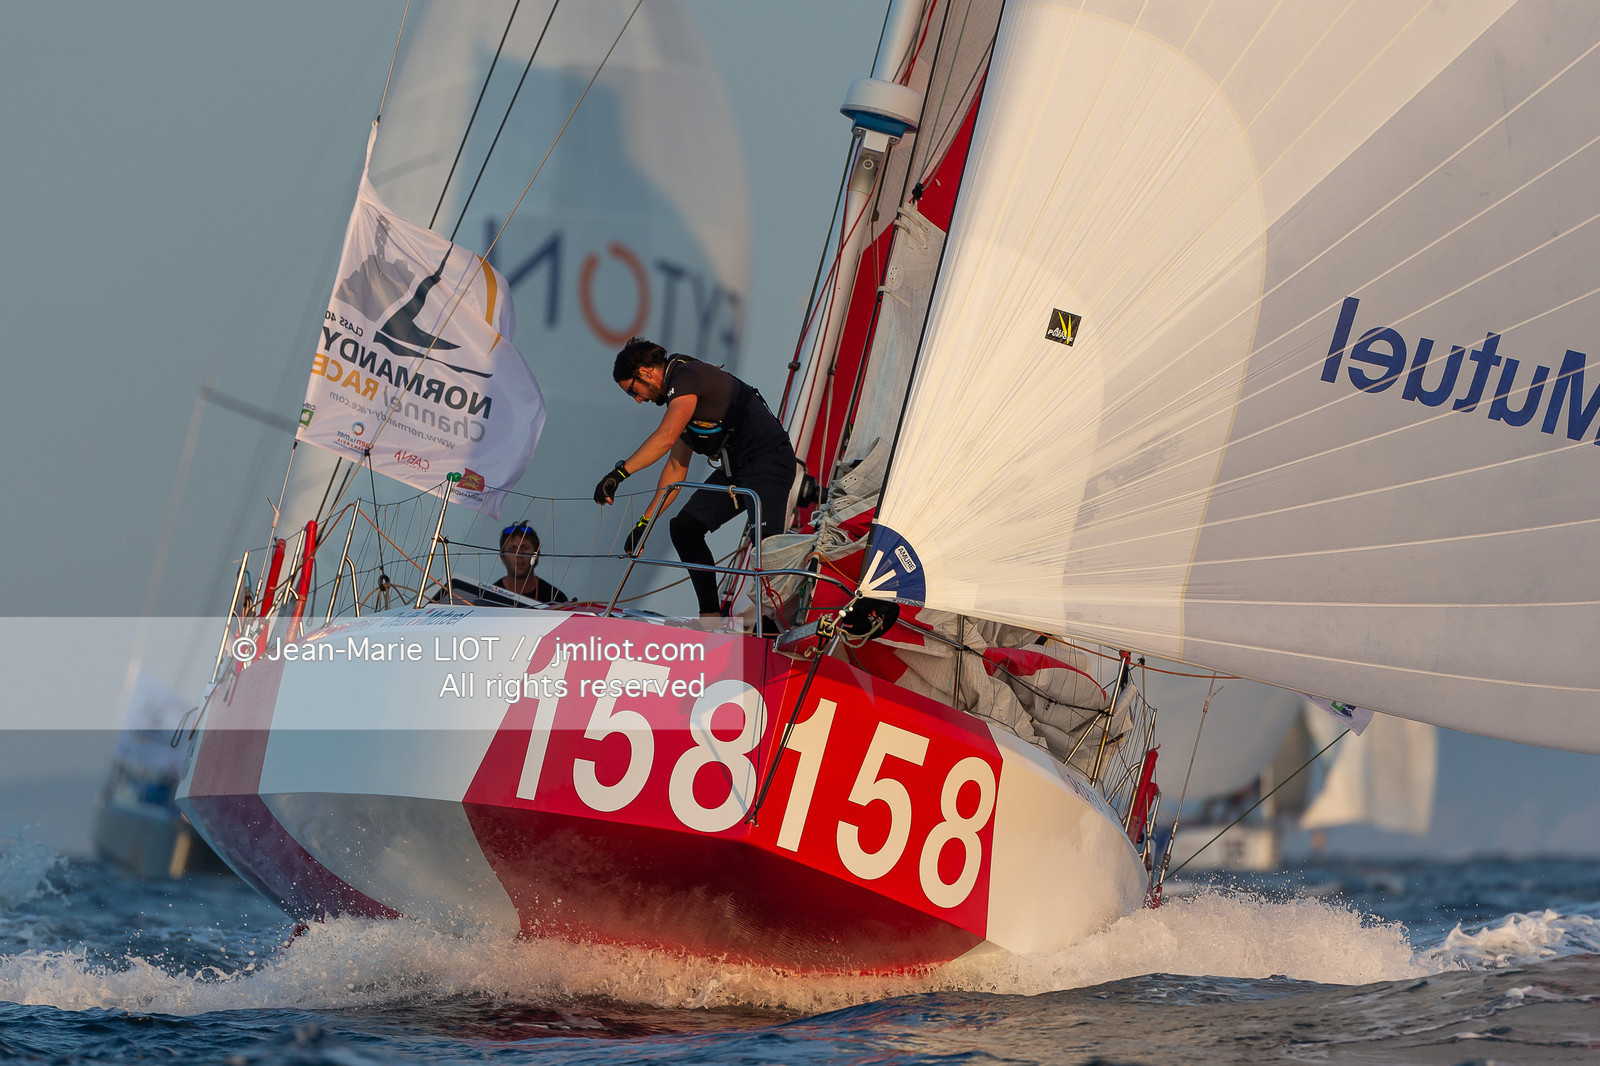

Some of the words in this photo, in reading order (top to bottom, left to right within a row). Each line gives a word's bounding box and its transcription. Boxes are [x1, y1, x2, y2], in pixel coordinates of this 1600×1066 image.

[898, 547, 916, 571] AMURE
[516, 653, 768, 832] 158
[776, 698, 996, 909] 158
